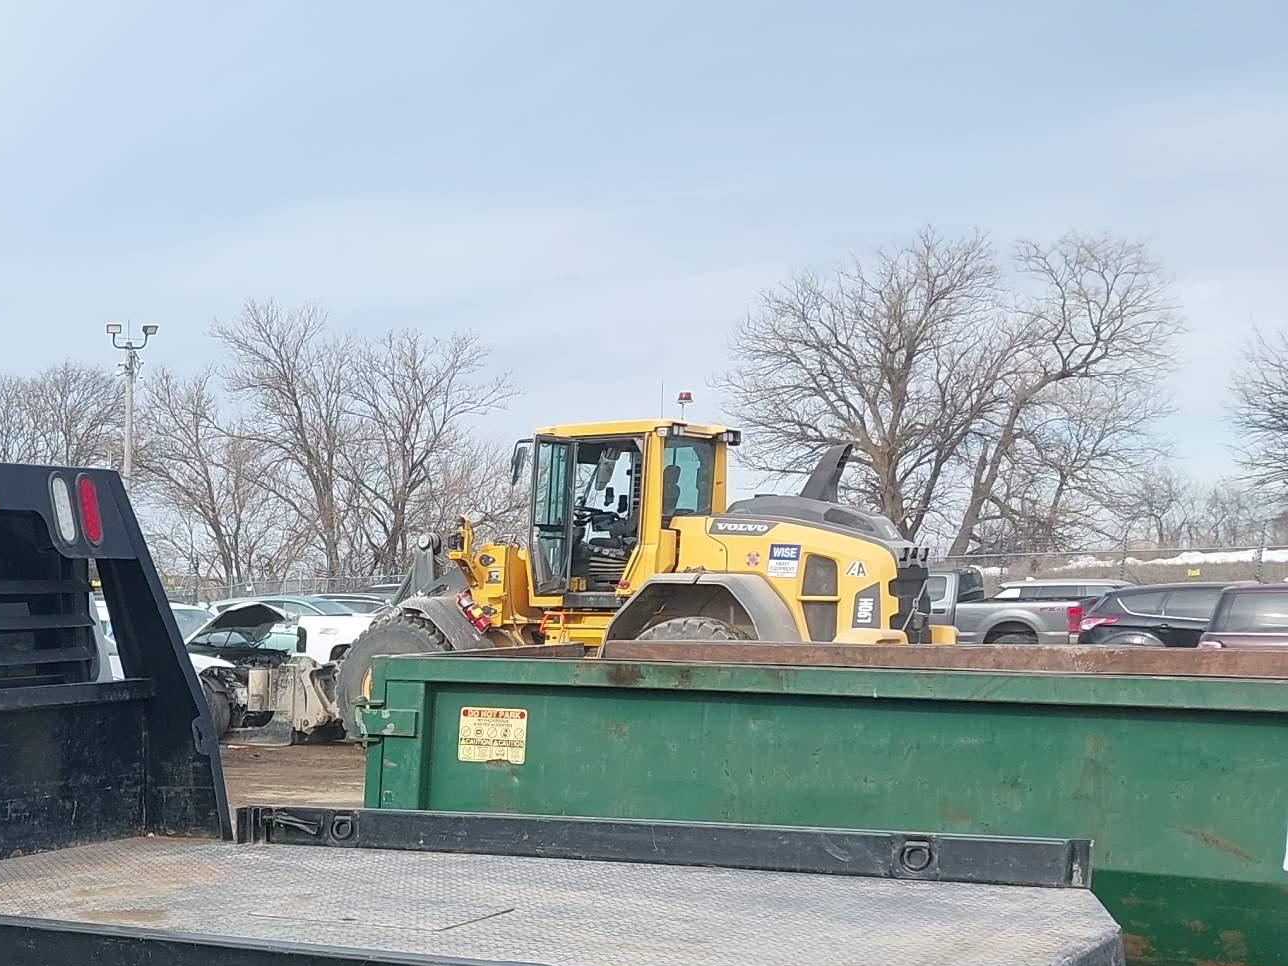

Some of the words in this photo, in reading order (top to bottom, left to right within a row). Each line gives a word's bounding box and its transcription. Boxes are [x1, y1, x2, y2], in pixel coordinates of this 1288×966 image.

[716, 522, 769, 532] VOLVO
[773, 547, 798, 558] WISE
[856, 597, 875, 623] L90H
[467, 709, 480, 718] DO
[480, 710, 498, 719] NOT
[499, 711, 520, 719] PARK
